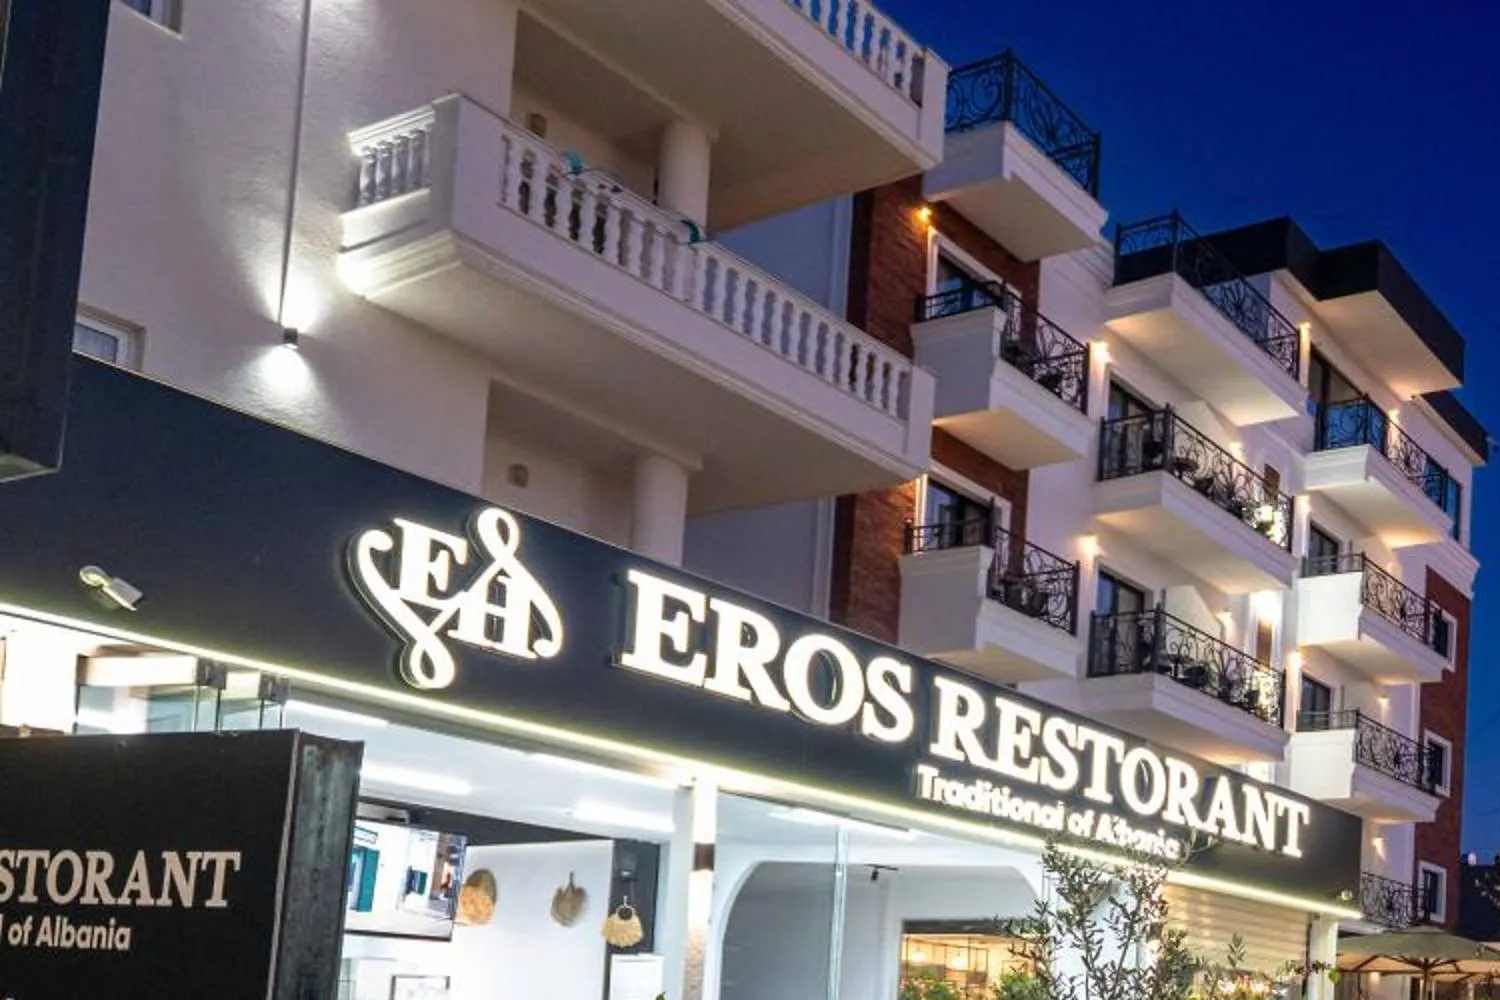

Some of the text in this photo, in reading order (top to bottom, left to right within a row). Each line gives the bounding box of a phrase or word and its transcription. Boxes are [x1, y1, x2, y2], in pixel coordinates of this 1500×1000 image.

[622, 569, 1311, 857] EROS RESTORANT
[917, 764, 1065, 831] Traditional
[1067, 808, 1095, 838] of
[8, 916, 33, 945] of
[36, 915, 131, 949] Albania
